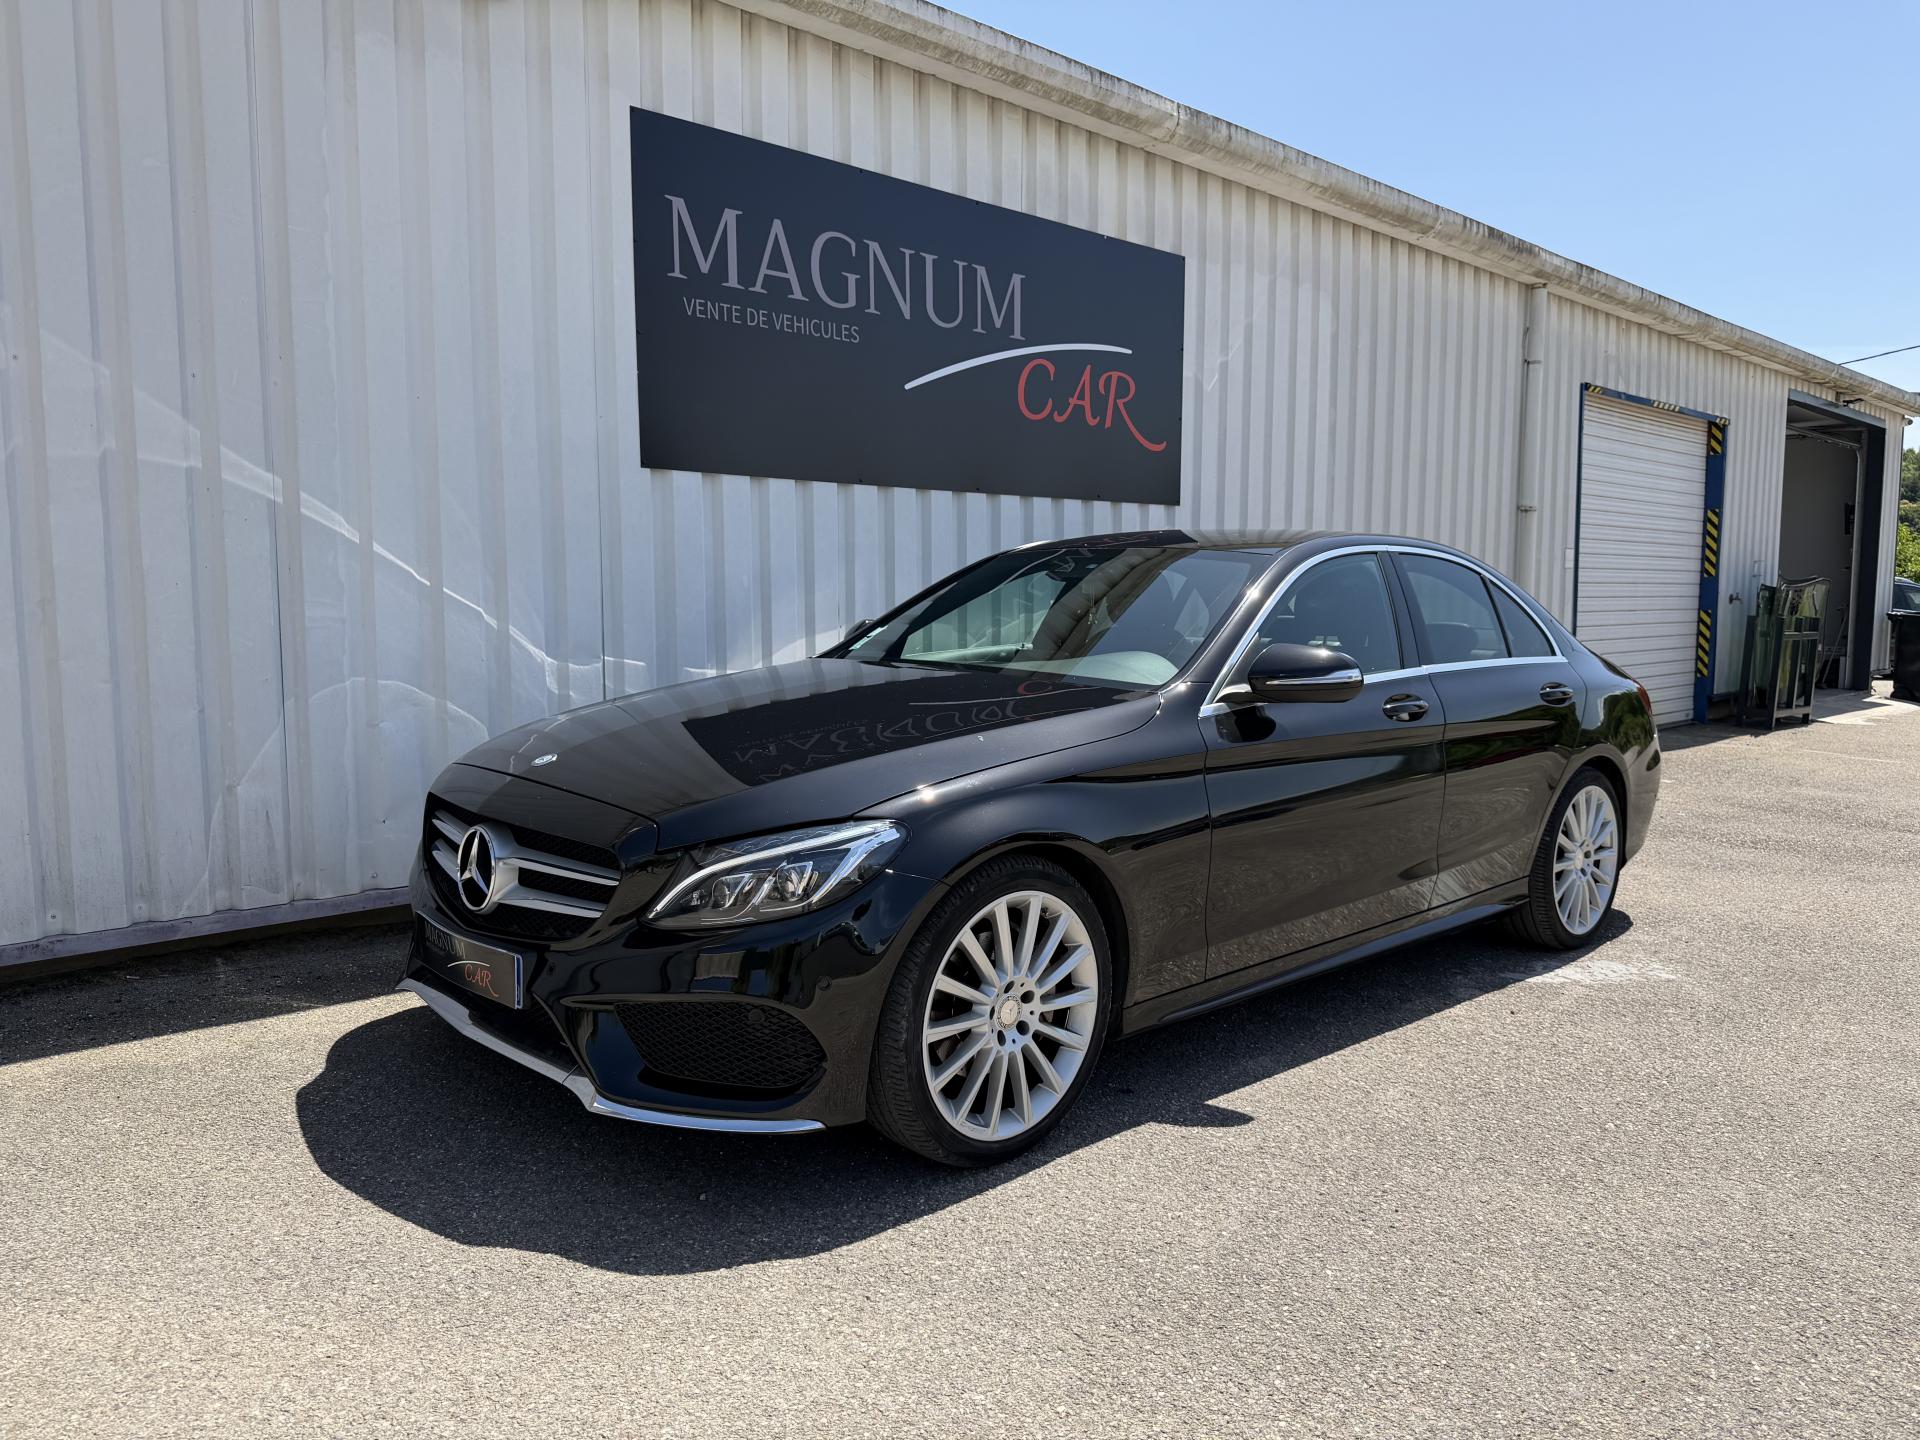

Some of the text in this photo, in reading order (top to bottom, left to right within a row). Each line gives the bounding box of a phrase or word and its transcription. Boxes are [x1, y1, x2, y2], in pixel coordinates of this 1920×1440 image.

[664, 194, 1027, 341] MAGNUM
[683, 296, 860, 344] VENTE DE VEHICULES
[1017, 358, 1167, 452] CAR
[424, 920, 466, 960] MAGNUM
[464, 963, 499, 997] CAR
